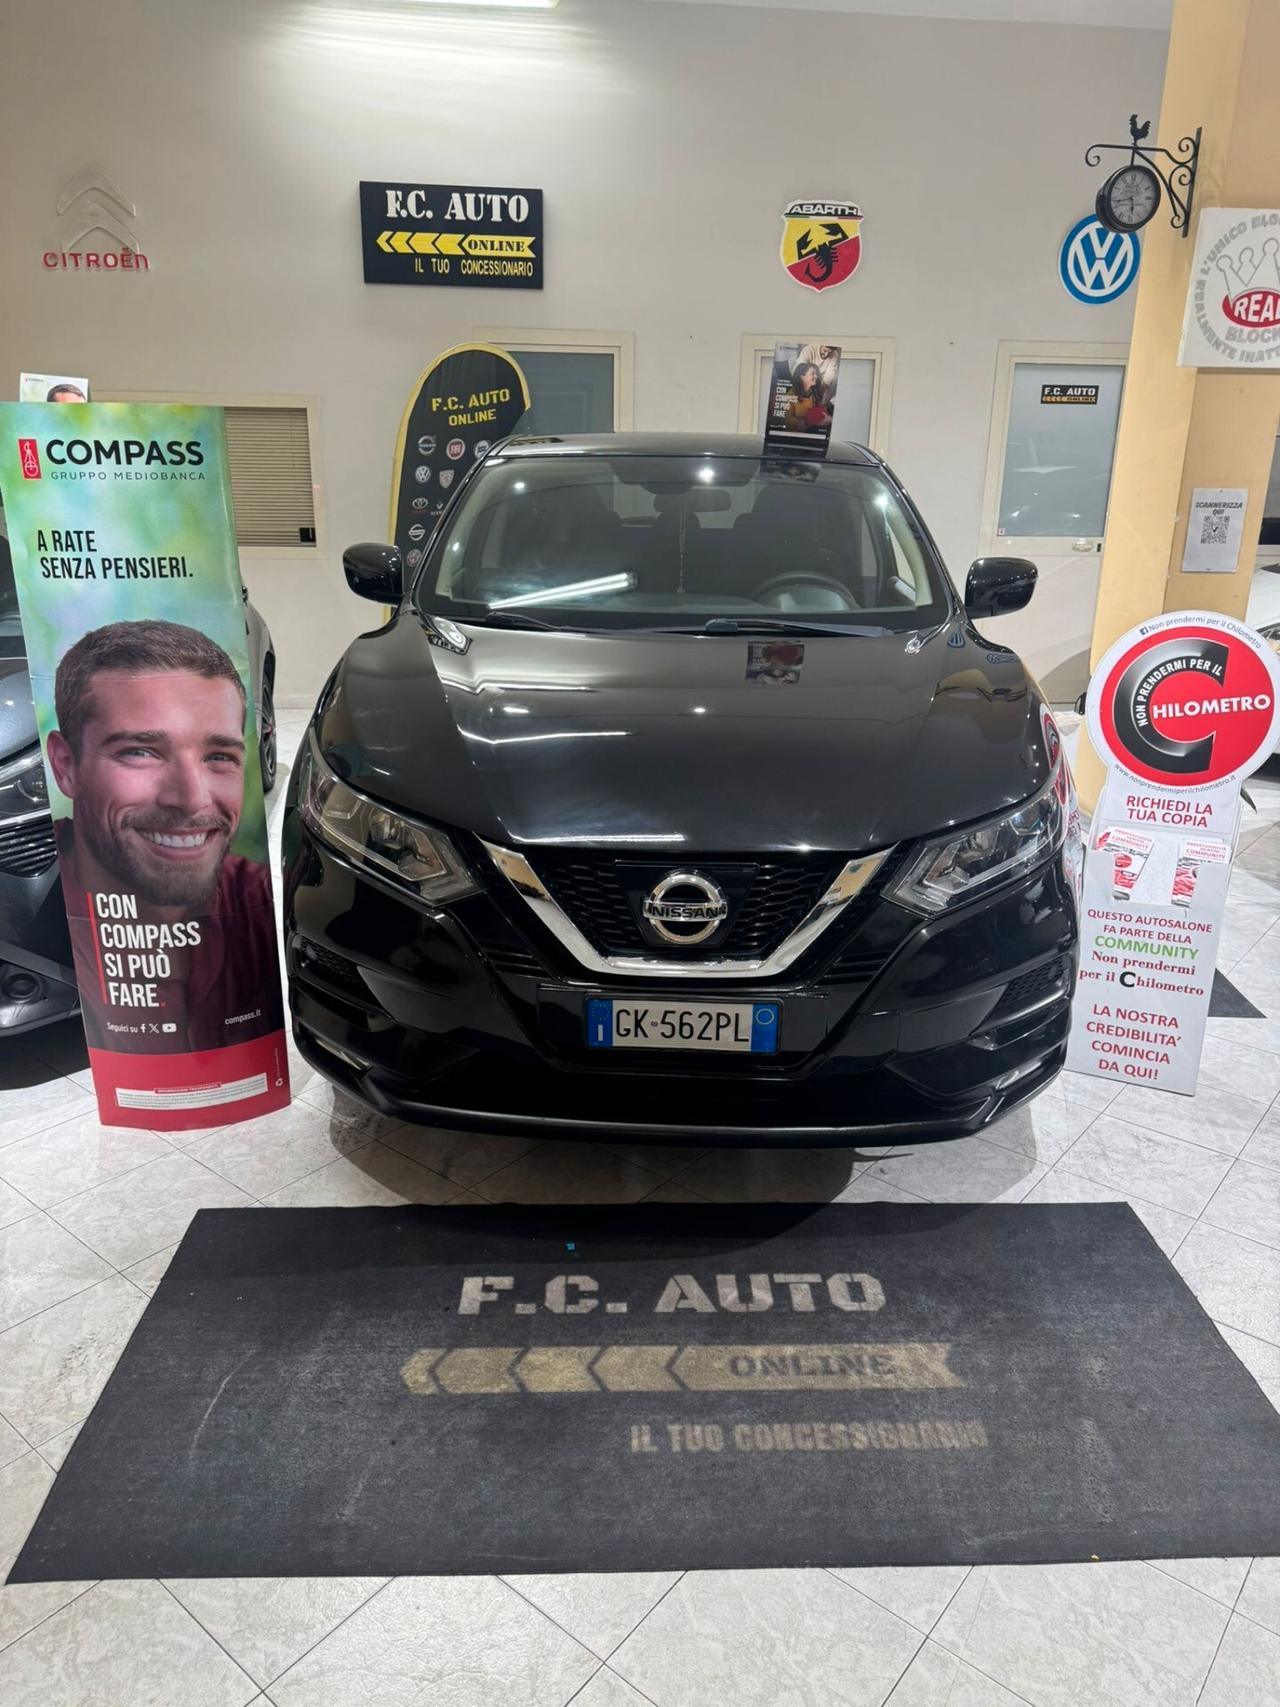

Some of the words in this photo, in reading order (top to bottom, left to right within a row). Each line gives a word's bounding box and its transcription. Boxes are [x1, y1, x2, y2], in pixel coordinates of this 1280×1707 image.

[385, 189, 434, 219] F.C.
[444, 192, 529, 223] AUTO
[790, 204, 857, 215] ABARTH
[467, 239, 525, 253] ONLINE
[414, 258, 424, 273] IL
[431, 258, 450, 274] TUO
[460, 259, 533, 277] CONCESSIONARIO
[1194, 279, 1238, 360] REALMENTE
[431, 397, 464, 412] F.C.
[468, 388, 511, 408] AUTO
[1066, 387, 1096, 396] AUTO
[448, 408, 497, 426] ONLINE
[45, 439, 204, 466] COMPASS
[51, 471, 107, 480] GRUPPO
[114, 471, 205, 481] MEDIOBANCA
[37, 530, 48, 551] A
[52, 530, 97, 552] RATE
[40, 557, 97, 579] SENZA
[101, 556, 194, 579] PENSIERI.
[1148, 621, 1165, 631] Non
[1165, 616, 1206, 627] prendermi
[1206, 617, 1219, 625] per
[1226, 622, 1262, 649] Chilometro
[1189, 658, 1211, 671] PER
[1212, 663, 1223, 677] IL
[1137, 658, 1187, 702] PRENDERMI
[1135, 704, 1149, 727] NON
[1126, 795, 1191, 813] RICHIEDI
[1195, 803, 1213, 815] LA
[1127, 808, 1157, 822] TUA
[1162, 812, 1208, 828] COPIA
[95, 892, 138, 920] CON
[652, 906, 718, 919] NISSAN
[1087, 908, 1133, 923] QUESTO
[1135, 915, 1213, 933] AUTOSALONE
[99, 921, 202, 949] COMPASS
[1103, 924, 1117, 934] FA
[1119, 926, 1154, 939] PARTE
[1157, 930, 1192, 944] DELLA
[1094, 935, 1199, 960] COMMUNITY
[104, 953, 124, 977] SI
[128, 948, 171, 978] PUÒ
[1091, 951, 1119, 964] Non
[1122, 957, 1196, 976] prendermi
[1079, 969, 1102, 980] per
[1105, 971, 1116, 982] il
[1119, 971, 1204, 997] Chilometro
[106, 1022, 129, 1033] Seguici
[129, 1025, 139, 1033] su
[224, 1009, 262, 1026] compass.it
[1093, 1003, 1111, 1017] LA
[1116, 1007, 1179, 1029] NOSTRA
[1091, 1040, 1170, 1065] COMINCIA
[1098, 1058, 1119, 1073] DA
[1124, 1063, 1159, 1080] QUI!
[457, 1274, 628, 1315] F.C.
[655, 1272, 887, 1313] AUTO
[728, 1353, 895, 1379] ONLINE
[630, 1425, 658, 1453] IL
[666, 1424, 724, 1453] TUO
